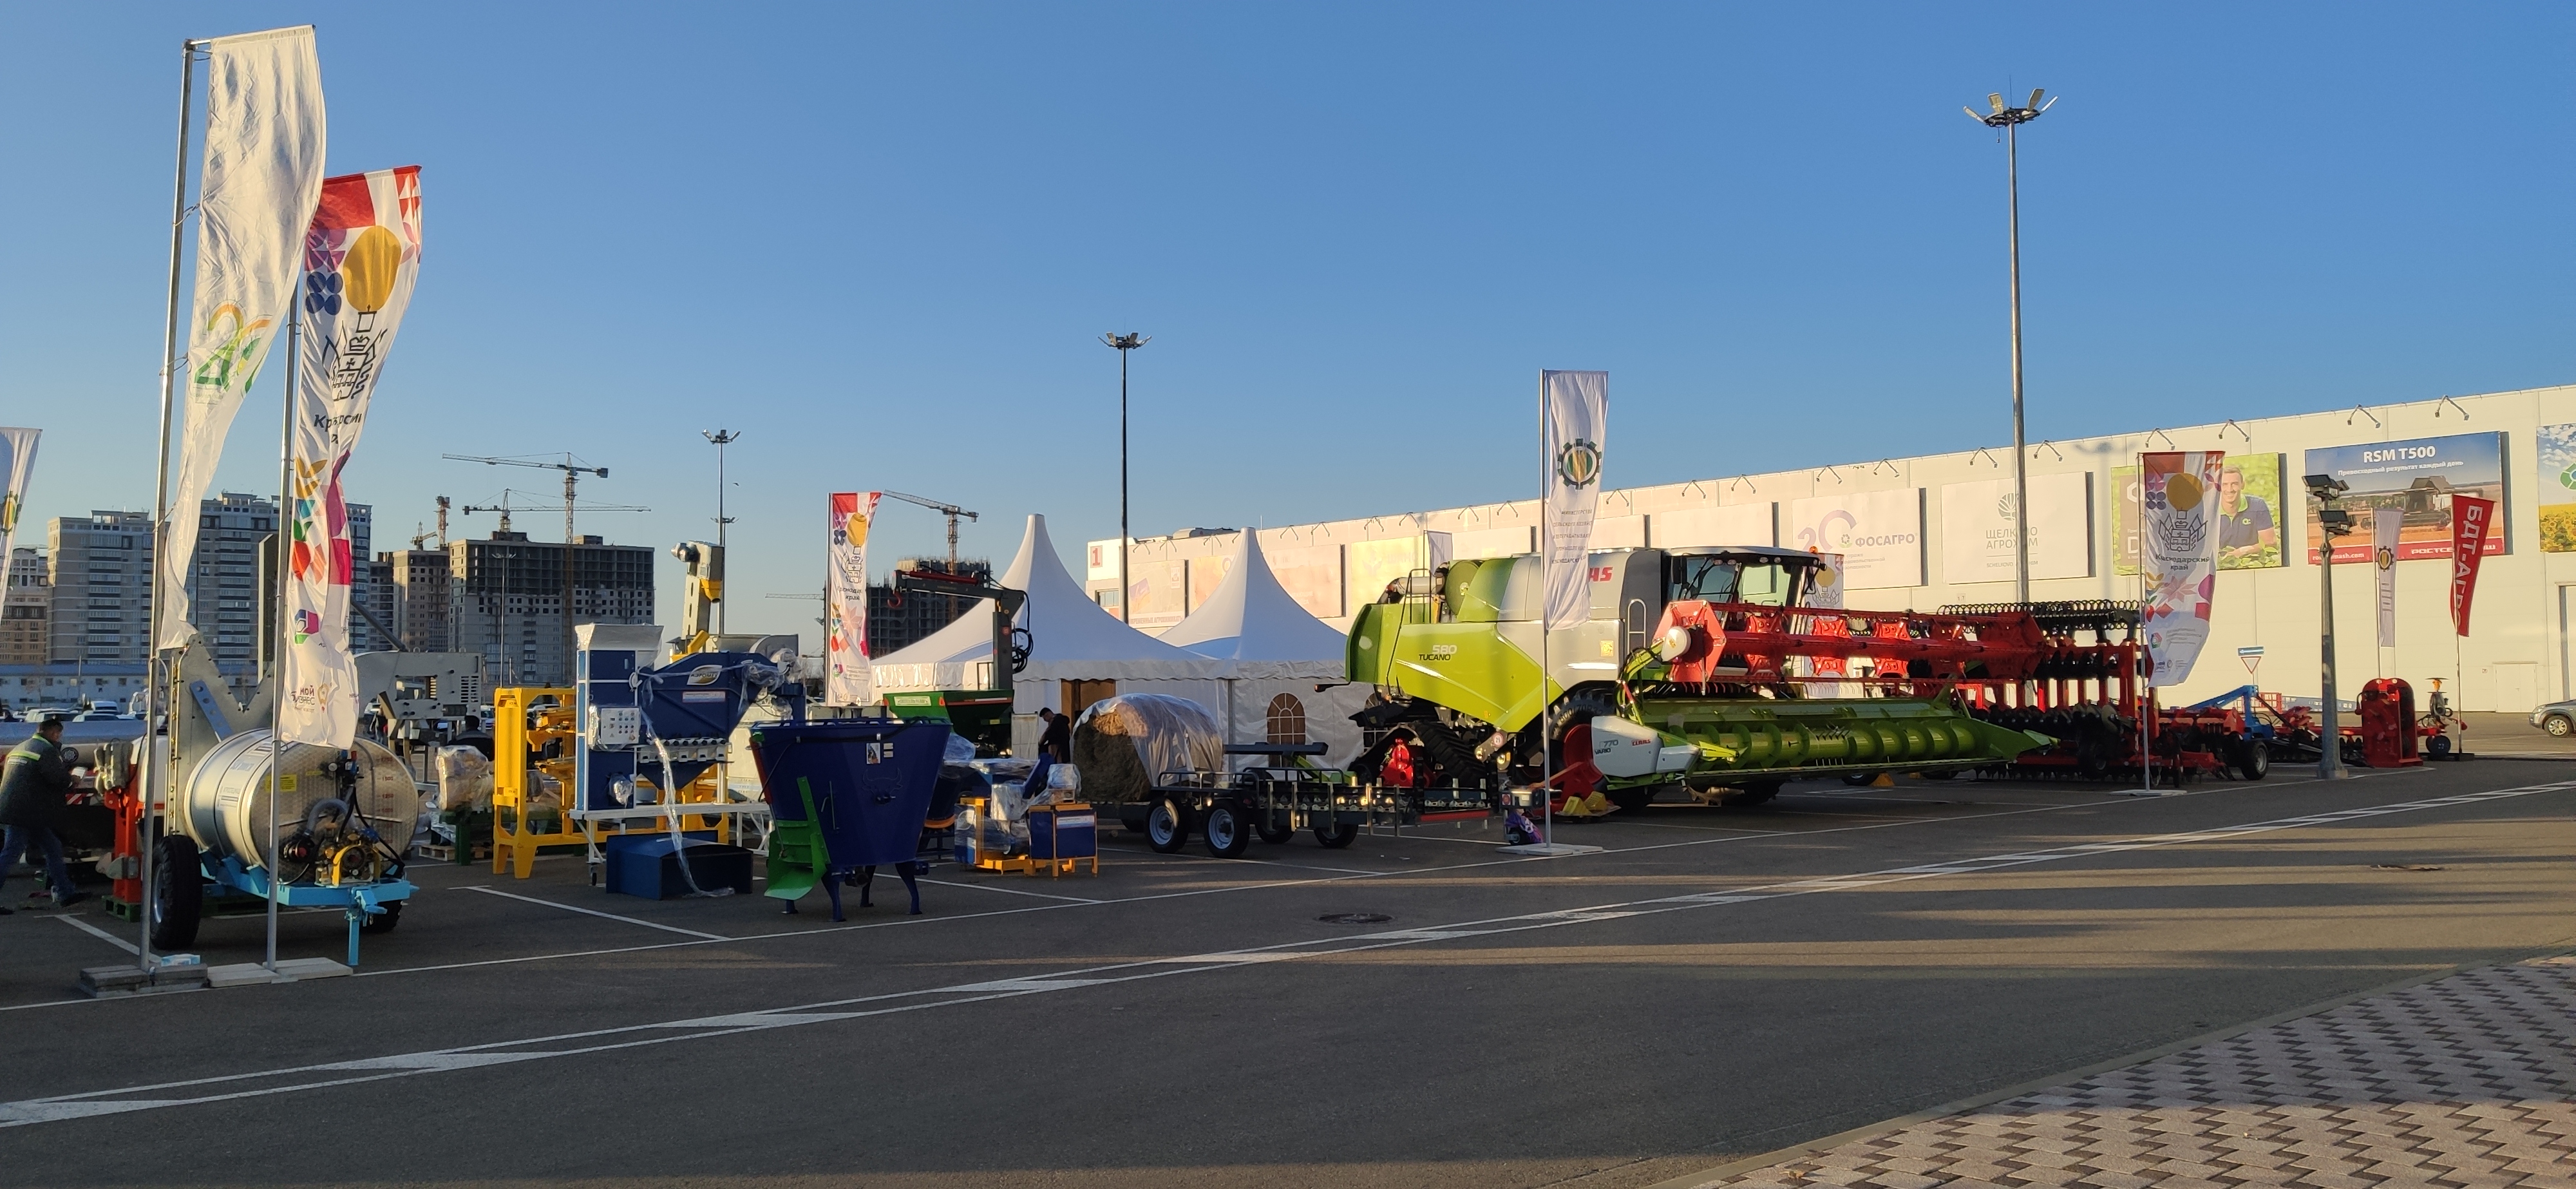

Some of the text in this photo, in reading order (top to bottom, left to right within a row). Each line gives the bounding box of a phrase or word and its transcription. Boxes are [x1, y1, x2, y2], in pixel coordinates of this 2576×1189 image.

[2363, 446, 2436, 463] RSM T500
[2338, 466, 2385, 476] Превосходный
[2386, 464, 2418, 473] результат
[1855, 533, 1915, 547] ФОСАГРО
[1092, 548, 1100, 566] 1
[2155, 553, 2210, 564] Краснодарский
[1432, 645, 1457, 654] 580
[299, 685, 314, 696] МОЙ
